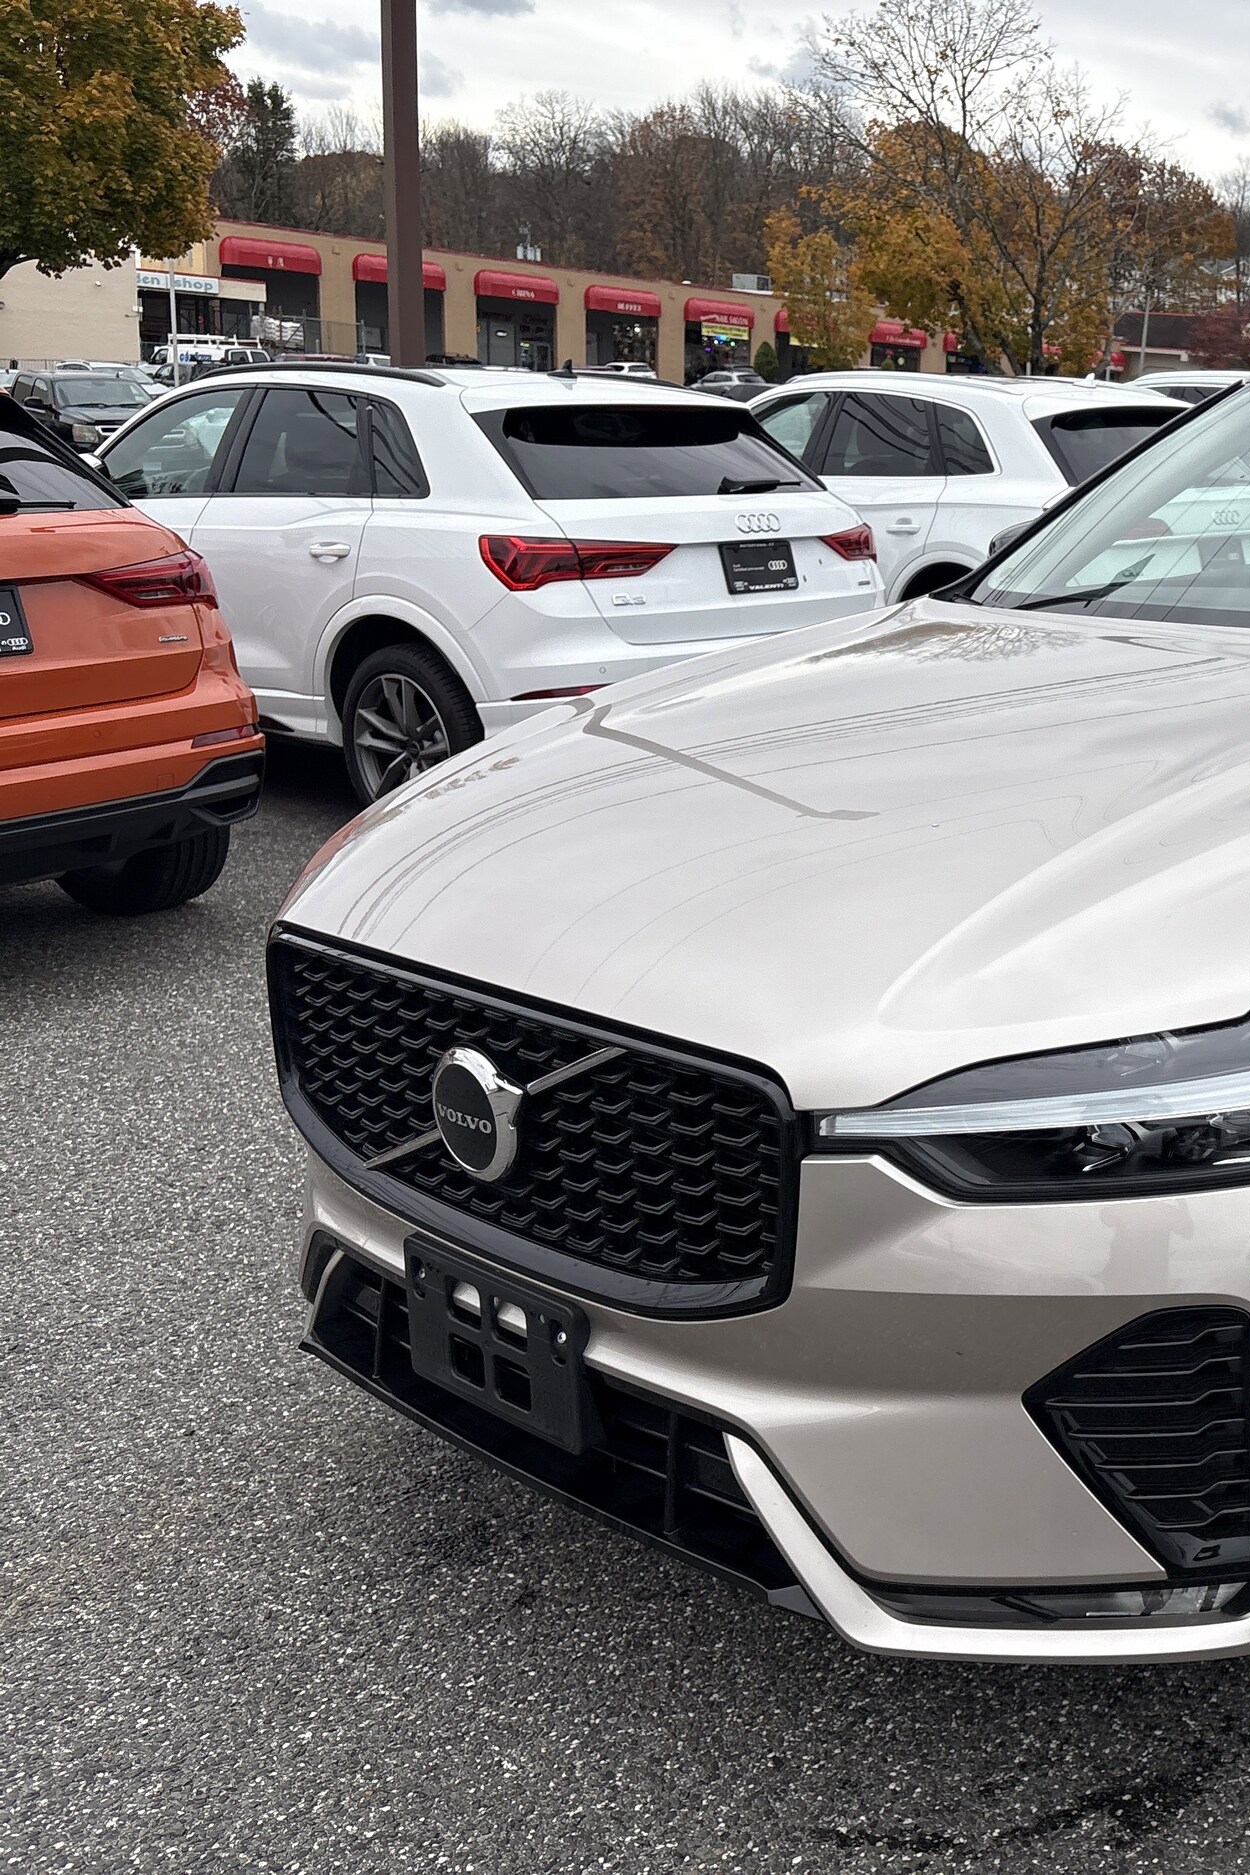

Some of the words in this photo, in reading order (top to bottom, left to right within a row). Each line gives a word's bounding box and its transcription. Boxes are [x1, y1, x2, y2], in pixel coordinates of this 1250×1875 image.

[174, 278, 213, 292] shop
[612, 593, 646, 606] Q3
[437, 1103, 492, 1134] VOLVO
